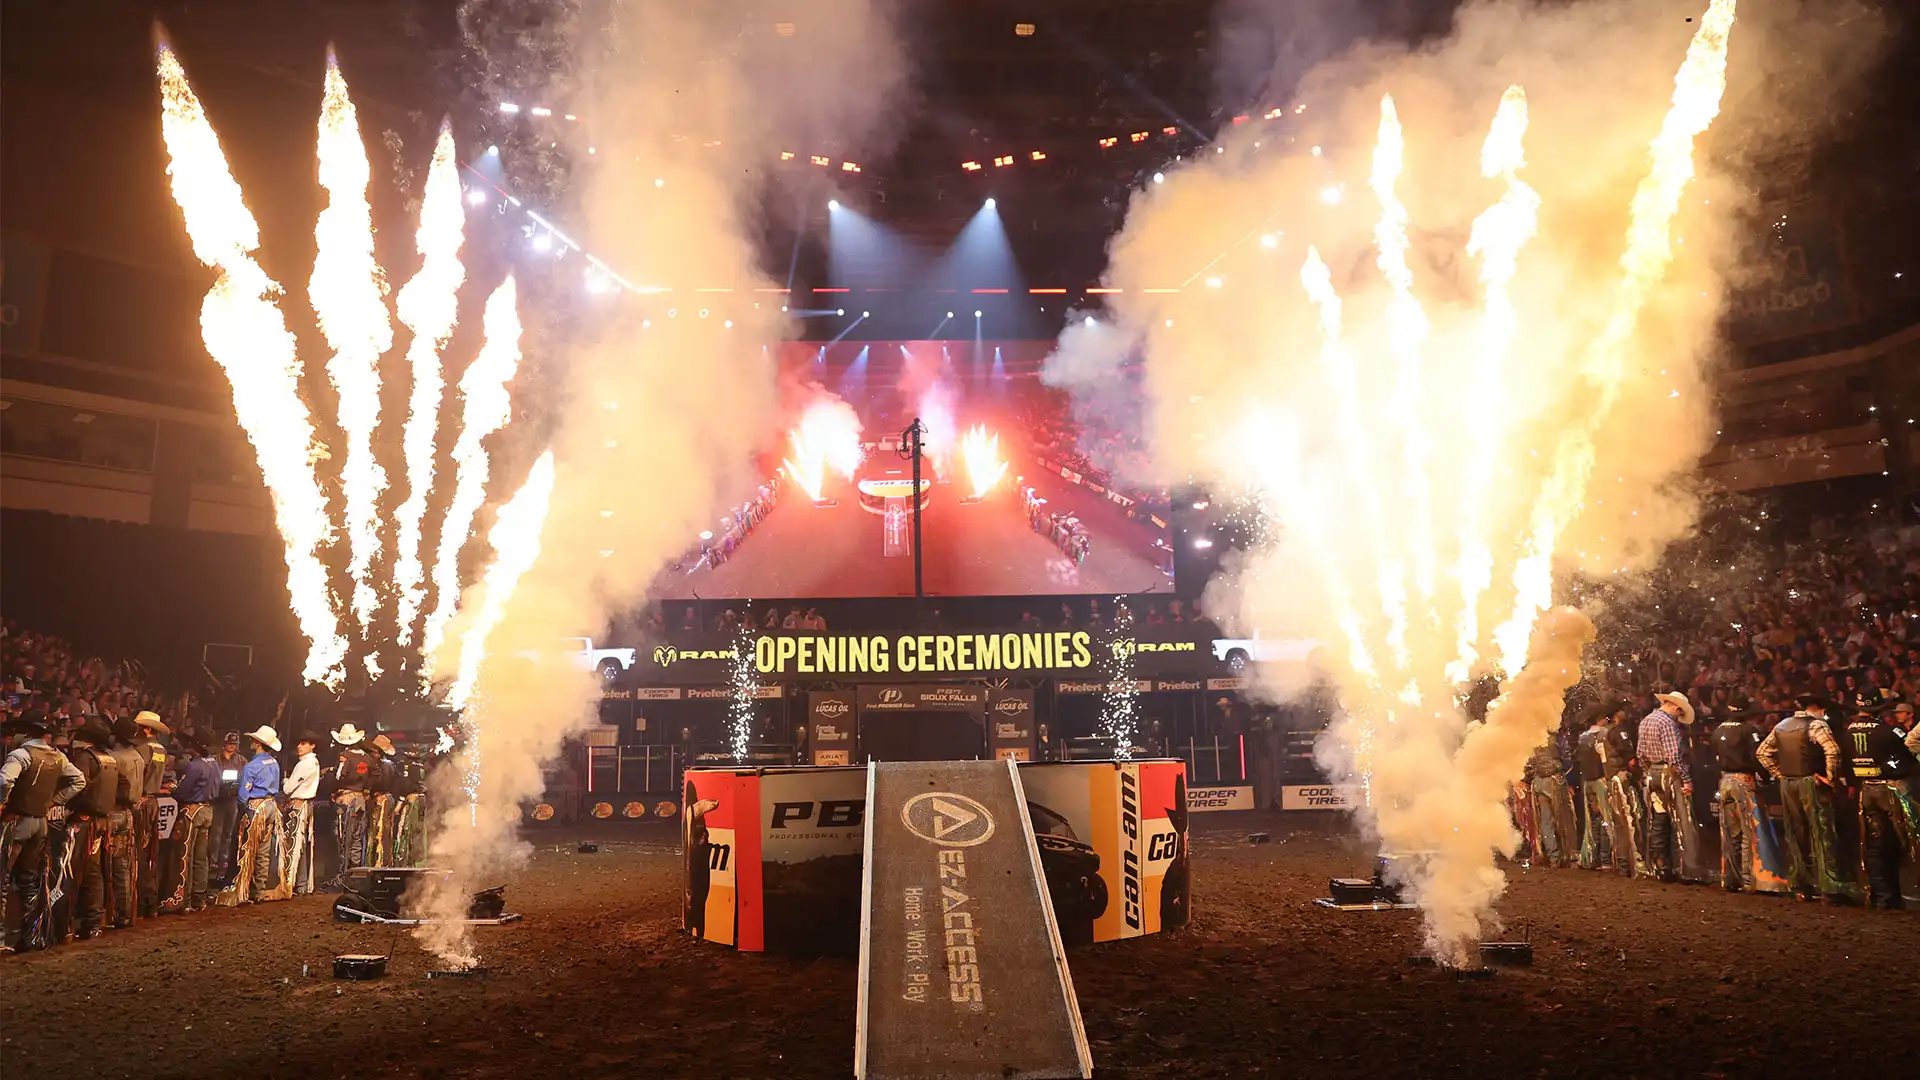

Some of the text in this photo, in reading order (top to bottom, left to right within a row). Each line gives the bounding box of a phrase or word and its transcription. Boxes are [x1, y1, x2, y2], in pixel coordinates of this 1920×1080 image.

[756, 631, 1092, 673] OPENING CEREMONIES
[1138, 642, 1195, 652] RAM
[680, 650, 737, 660] RAM
[1059, 682, 1102, 692] Priefert
[1158, 681, 1200, 690] Priefert
[604, 689, 631, 699] efert
[687, 688, 732, 698] Priefert
[949, 694, 977, 702] FALLS
[838, 704, 849, 712] OIL
[1017, 702, 1028, 710] OIL
[1187, 789, 1237, 799] OOPER
[1187, 798, 1228, 807] TIRES
[771, 801, 866, 829] PB
[769, 832, 840, 840] PROFESSIONAL
[1121, 772, 1140, 930] can-am
[902, 887, 930, 1004] Home Work Play
